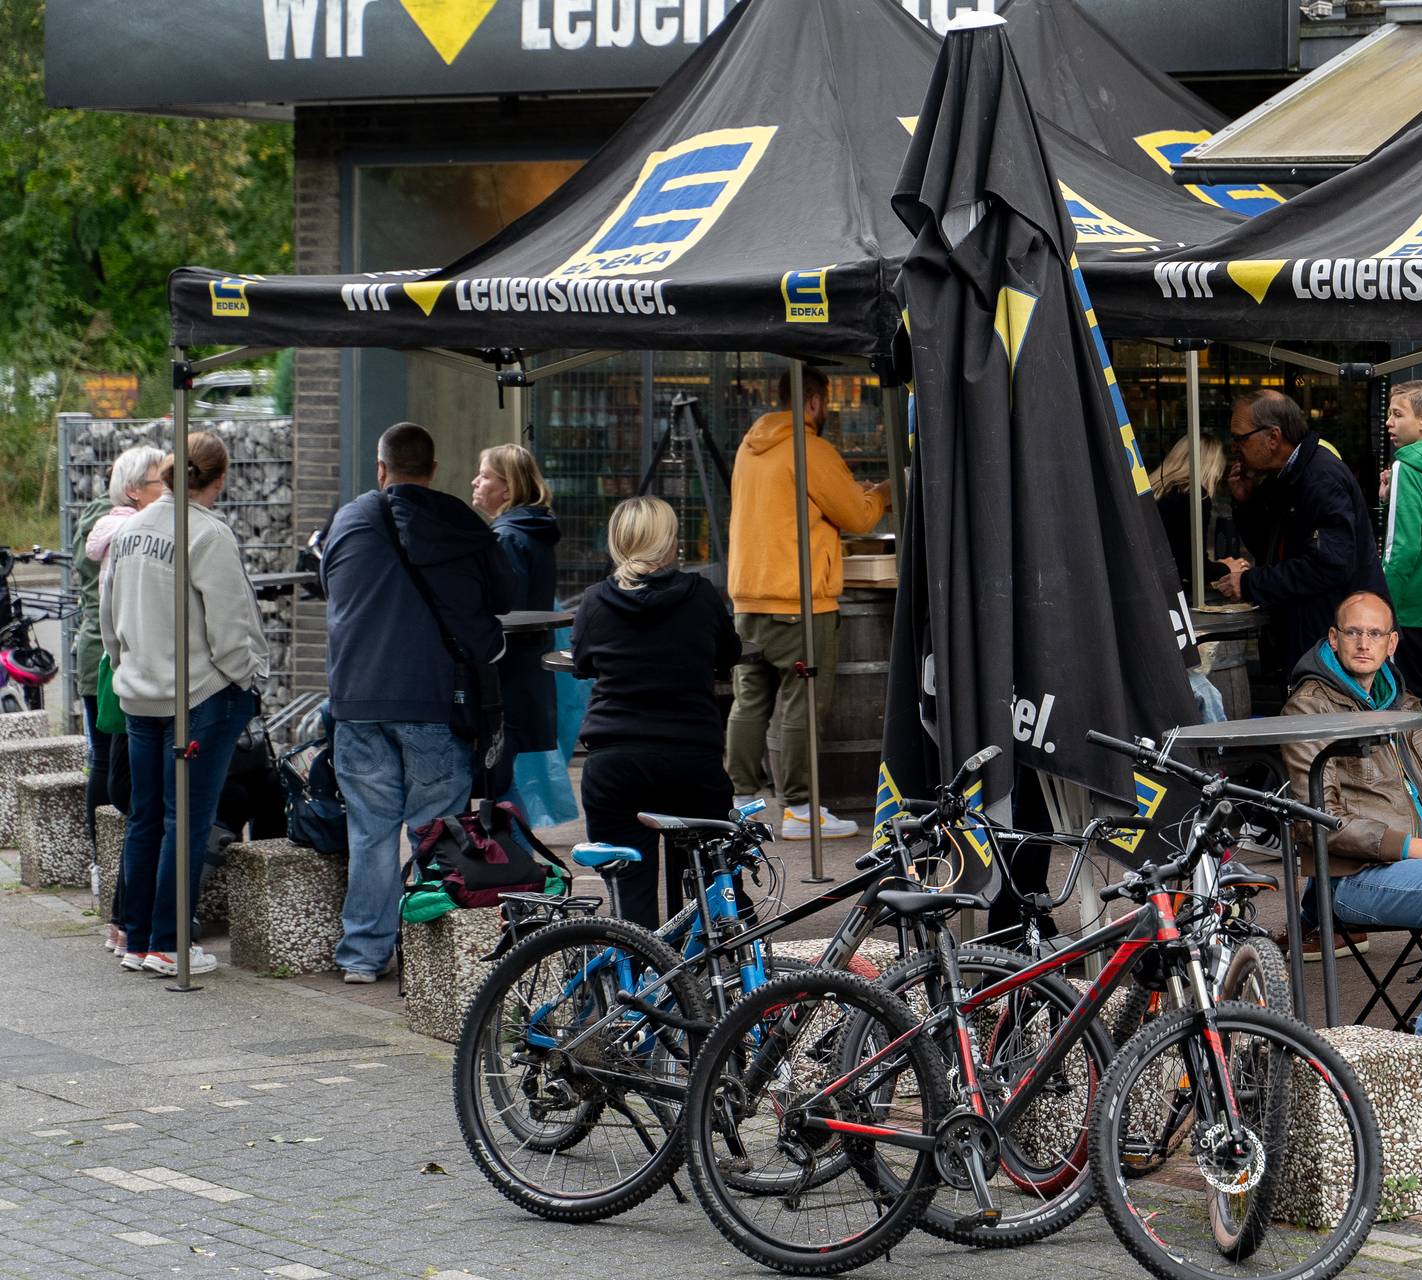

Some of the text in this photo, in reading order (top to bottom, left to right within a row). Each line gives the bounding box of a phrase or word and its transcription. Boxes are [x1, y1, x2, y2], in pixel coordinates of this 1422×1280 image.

[1076, 223, 1135, 236] EKA
[560, 249, 672, 276] EDEKA
[1153, 261, 1221, 298] Wir
[216, 302, 246, 310] EDEKA
[456, 277, 677, 316] Lebensmittel.
[790, 307, 825, 316] EDEKA
[142, 534, 176, 564] DAVI
